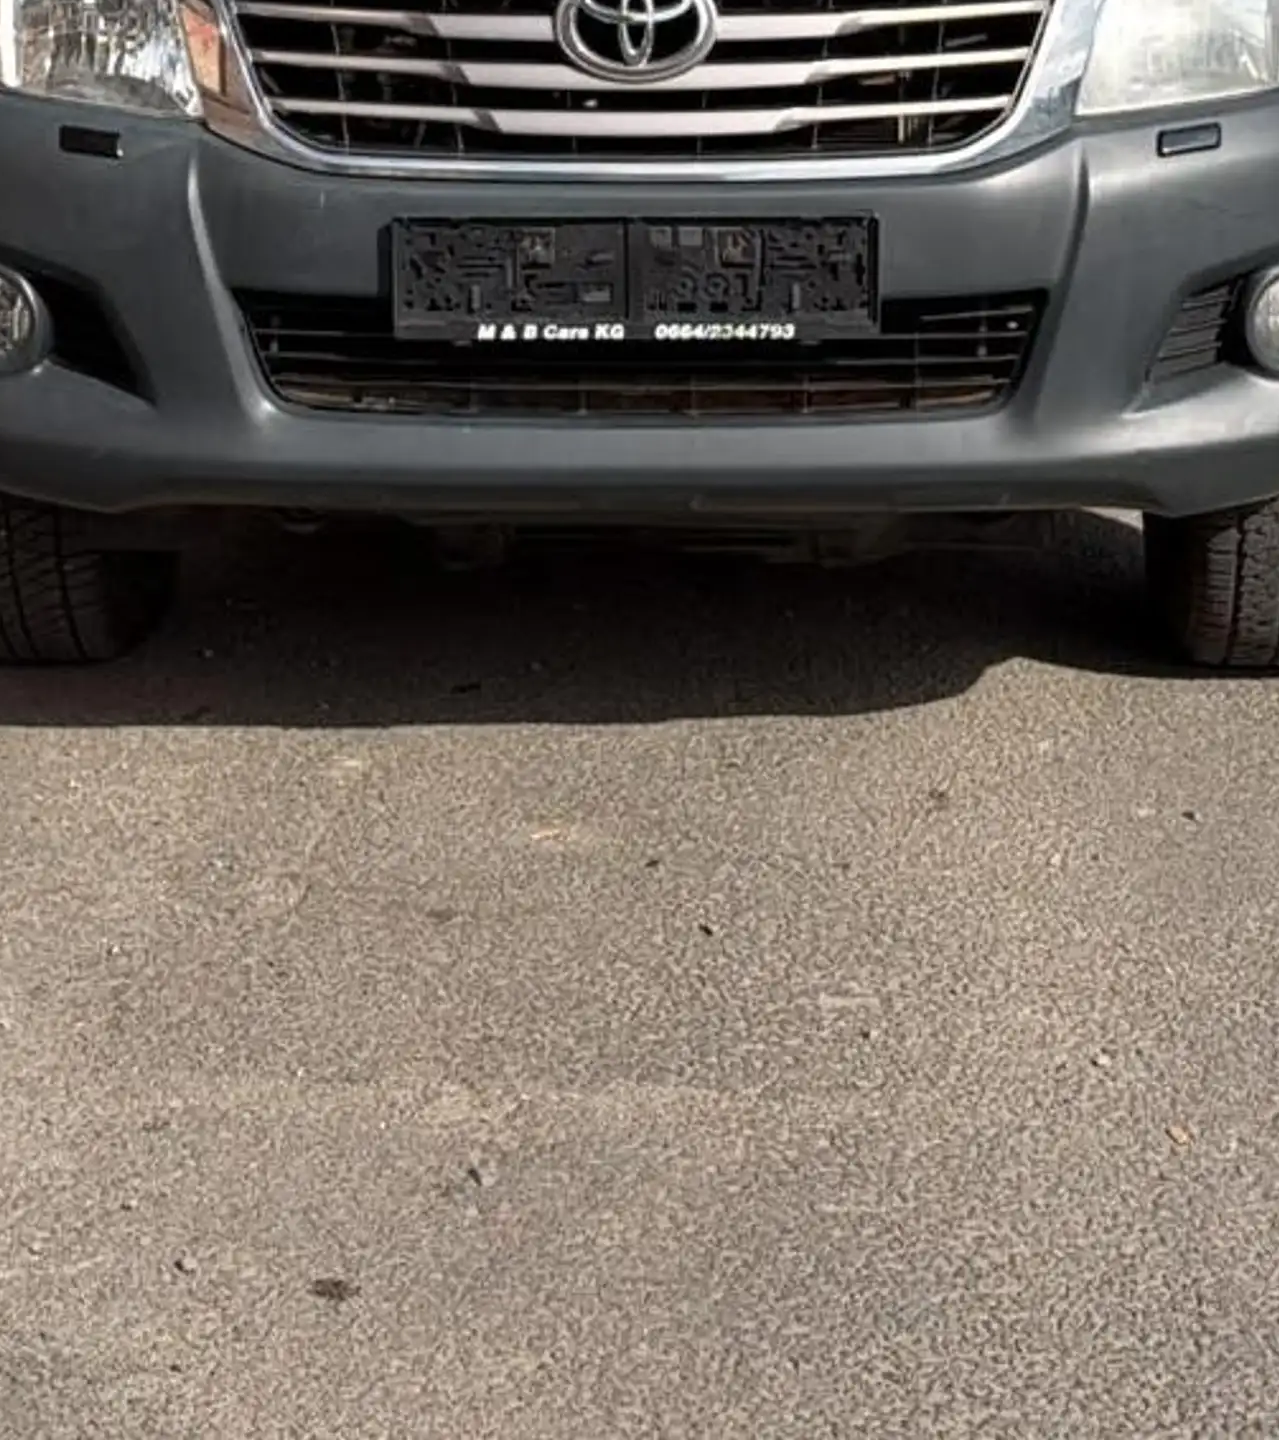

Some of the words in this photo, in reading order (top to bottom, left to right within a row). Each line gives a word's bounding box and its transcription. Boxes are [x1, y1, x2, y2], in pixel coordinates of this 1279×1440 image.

[478, 323, 496, 341] M
[543, 323, 589, 341] Cars
[595, 323, 625, 341] KG
